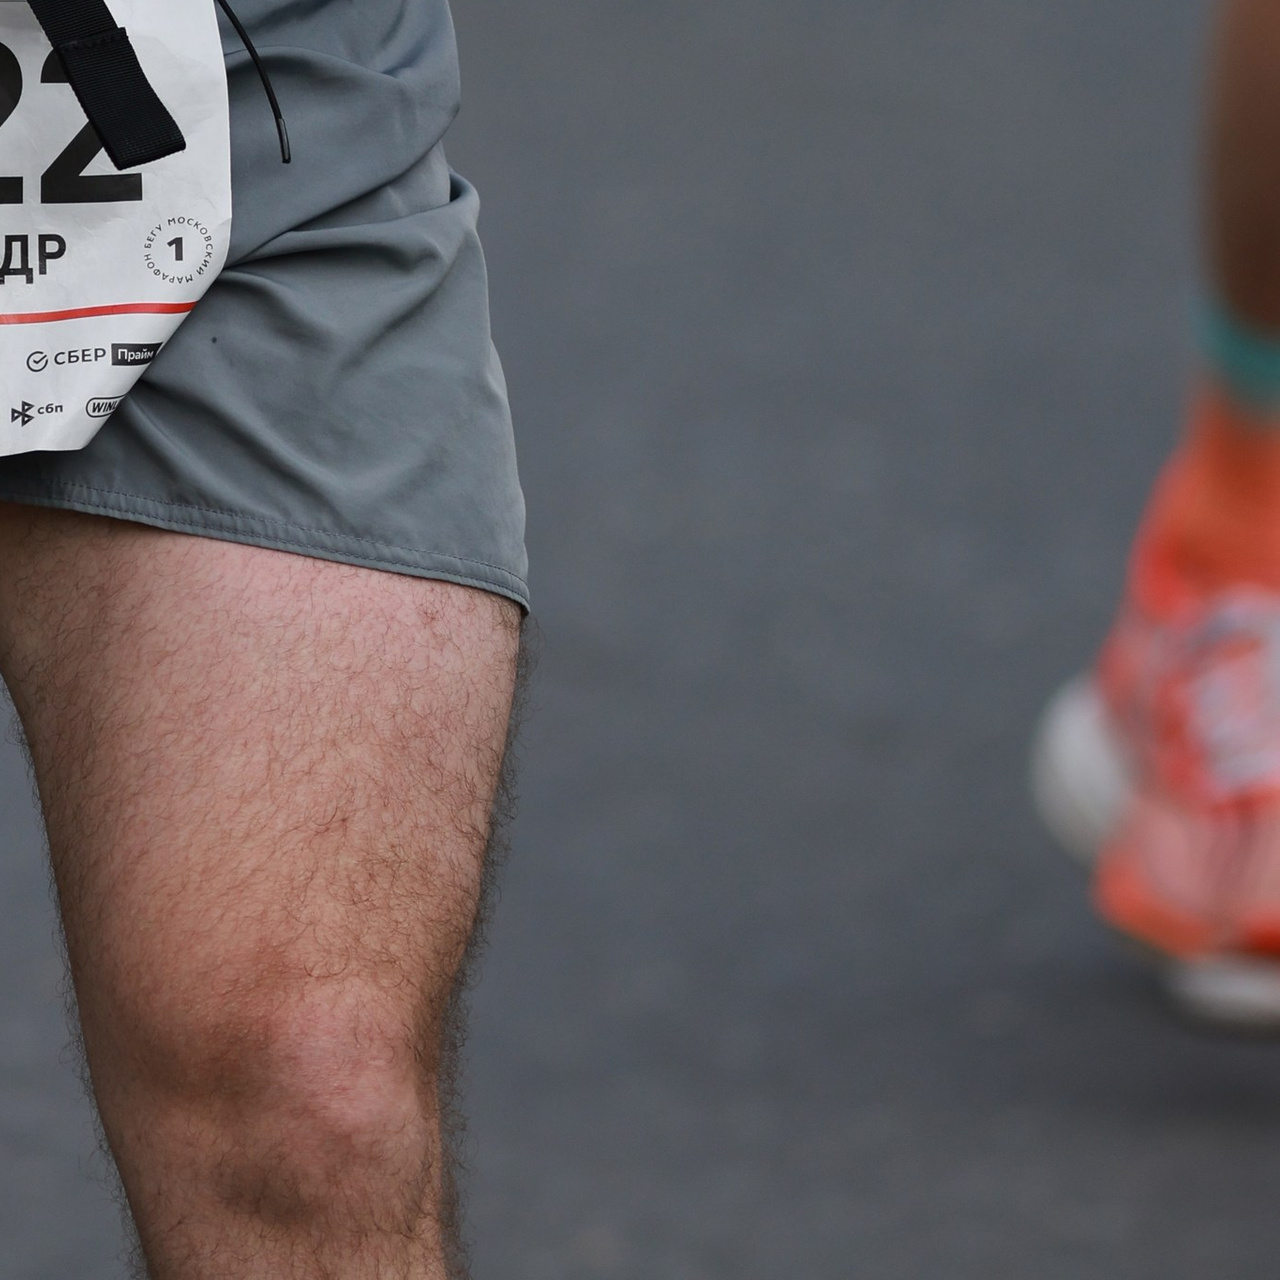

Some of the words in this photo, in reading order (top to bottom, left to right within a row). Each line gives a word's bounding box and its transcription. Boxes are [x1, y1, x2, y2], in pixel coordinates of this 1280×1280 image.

[143, 223, 163, 249] БЕГУ
[166, 236, 184, 262] 1
[167, 216, 214, 276] МОСКОВСКИЙ
[143, 253, 194, 284] МАРАФОН
[54, 347, 107, 366] СБЕР
[117, 348, 155, 363] Прайм
[37, 402, 64, 415] сбп
